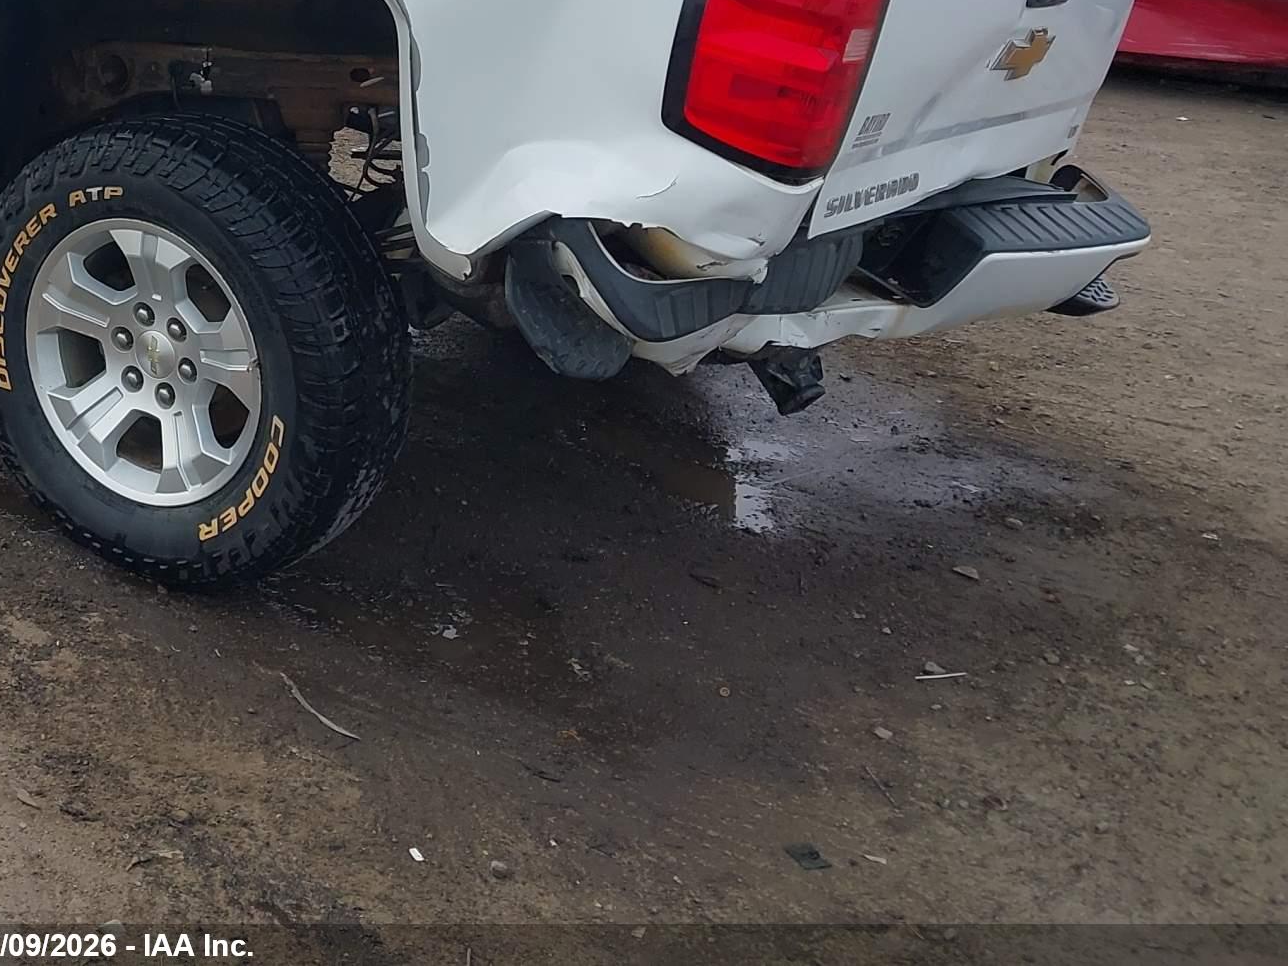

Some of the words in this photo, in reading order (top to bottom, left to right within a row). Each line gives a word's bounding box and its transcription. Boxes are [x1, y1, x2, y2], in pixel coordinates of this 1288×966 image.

[69, 186, 124, 207] ATP
[824, 172, 919, 218] SILVERADO
[198, 415, 285, 542] COOPER
